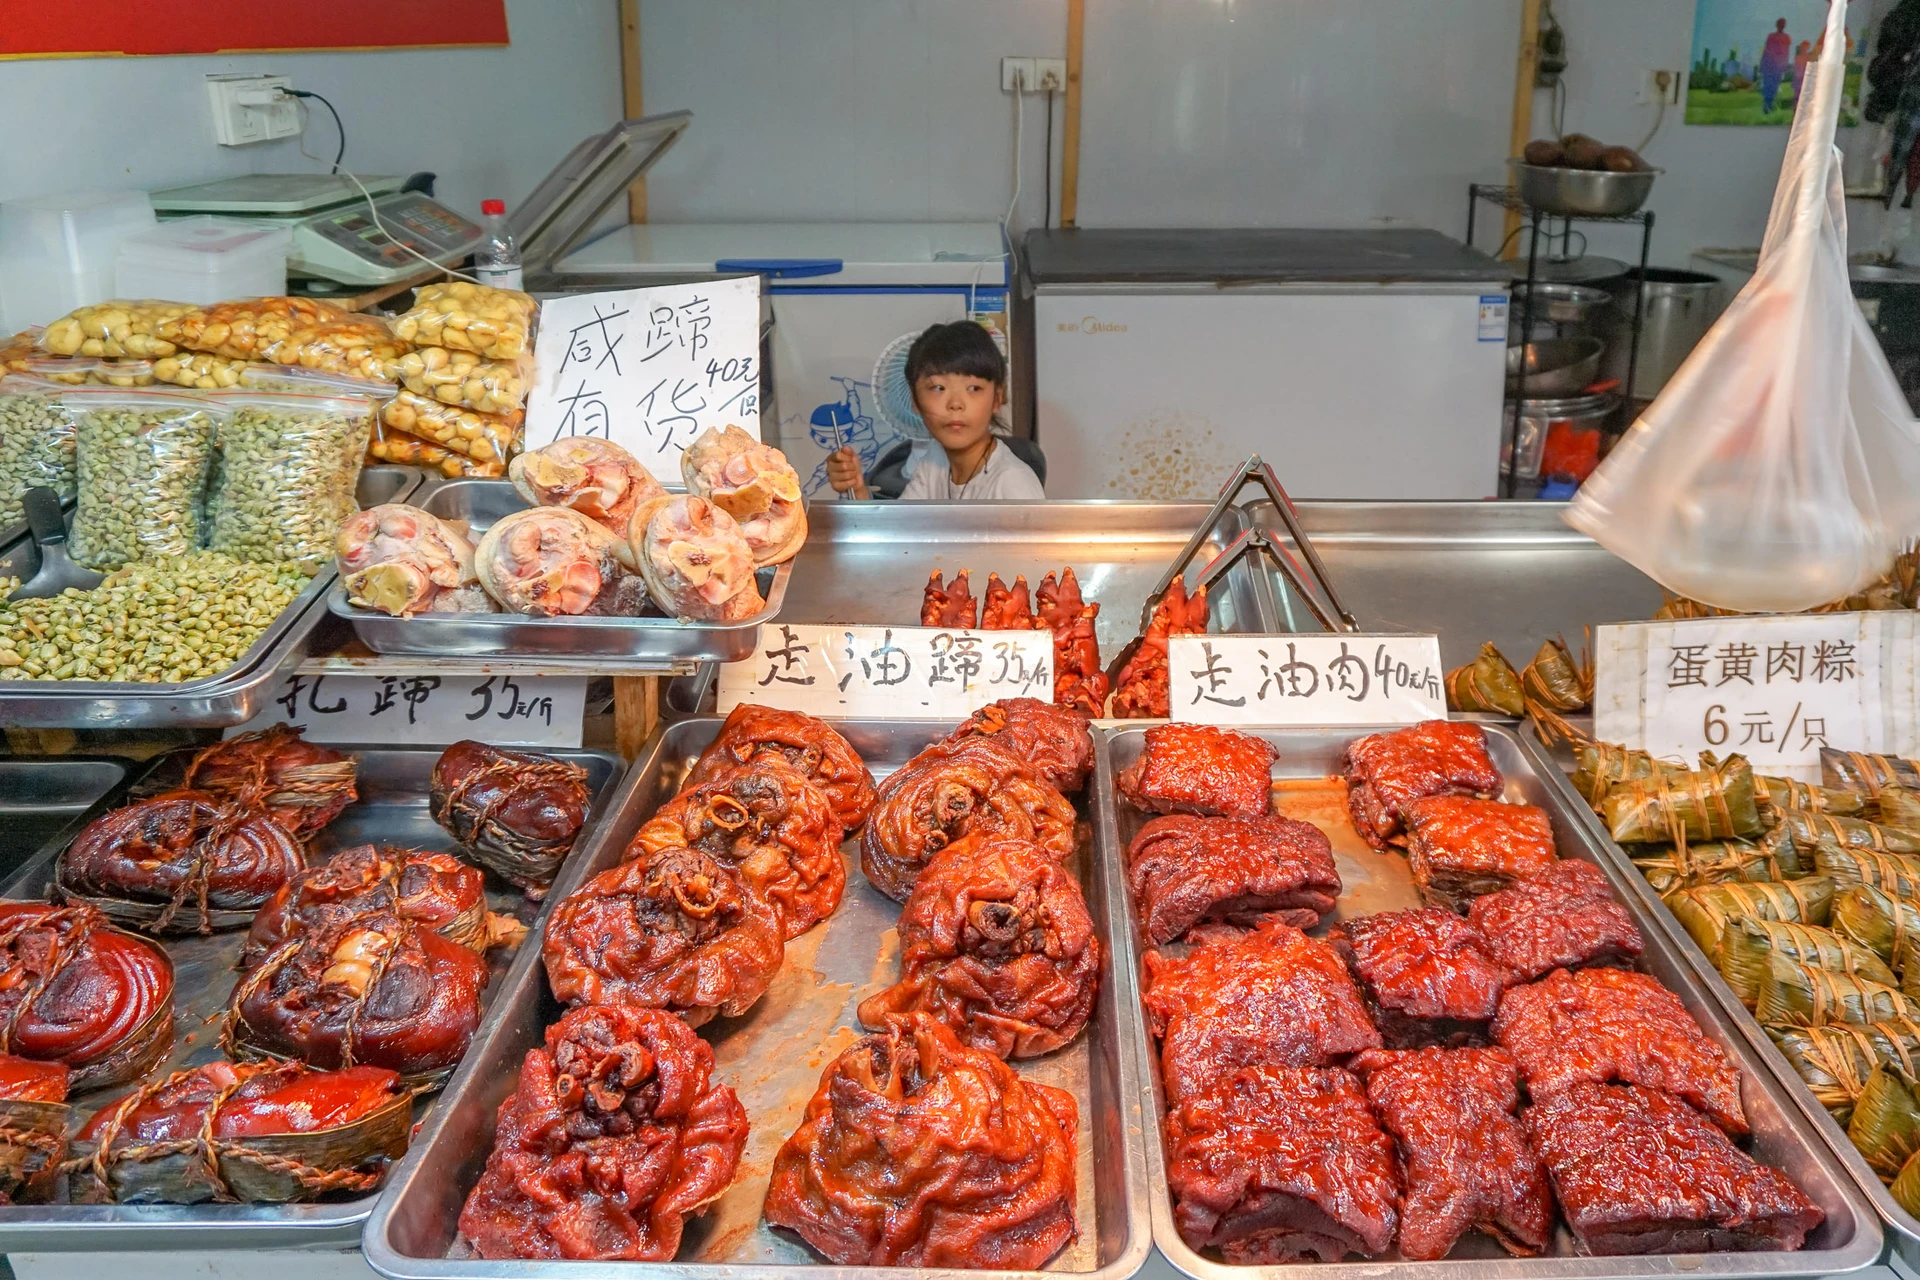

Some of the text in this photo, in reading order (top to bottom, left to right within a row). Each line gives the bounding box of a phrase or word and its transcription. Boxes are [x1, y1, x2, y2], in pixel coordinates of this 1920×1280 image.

[1088, 320, 1128, 333] Midea
[552, 378, 706, 453] 有货
[1667, 639, 1858, 688] 蛋黄肉粽
[1703, 701, 1830, 753] 6元/只
